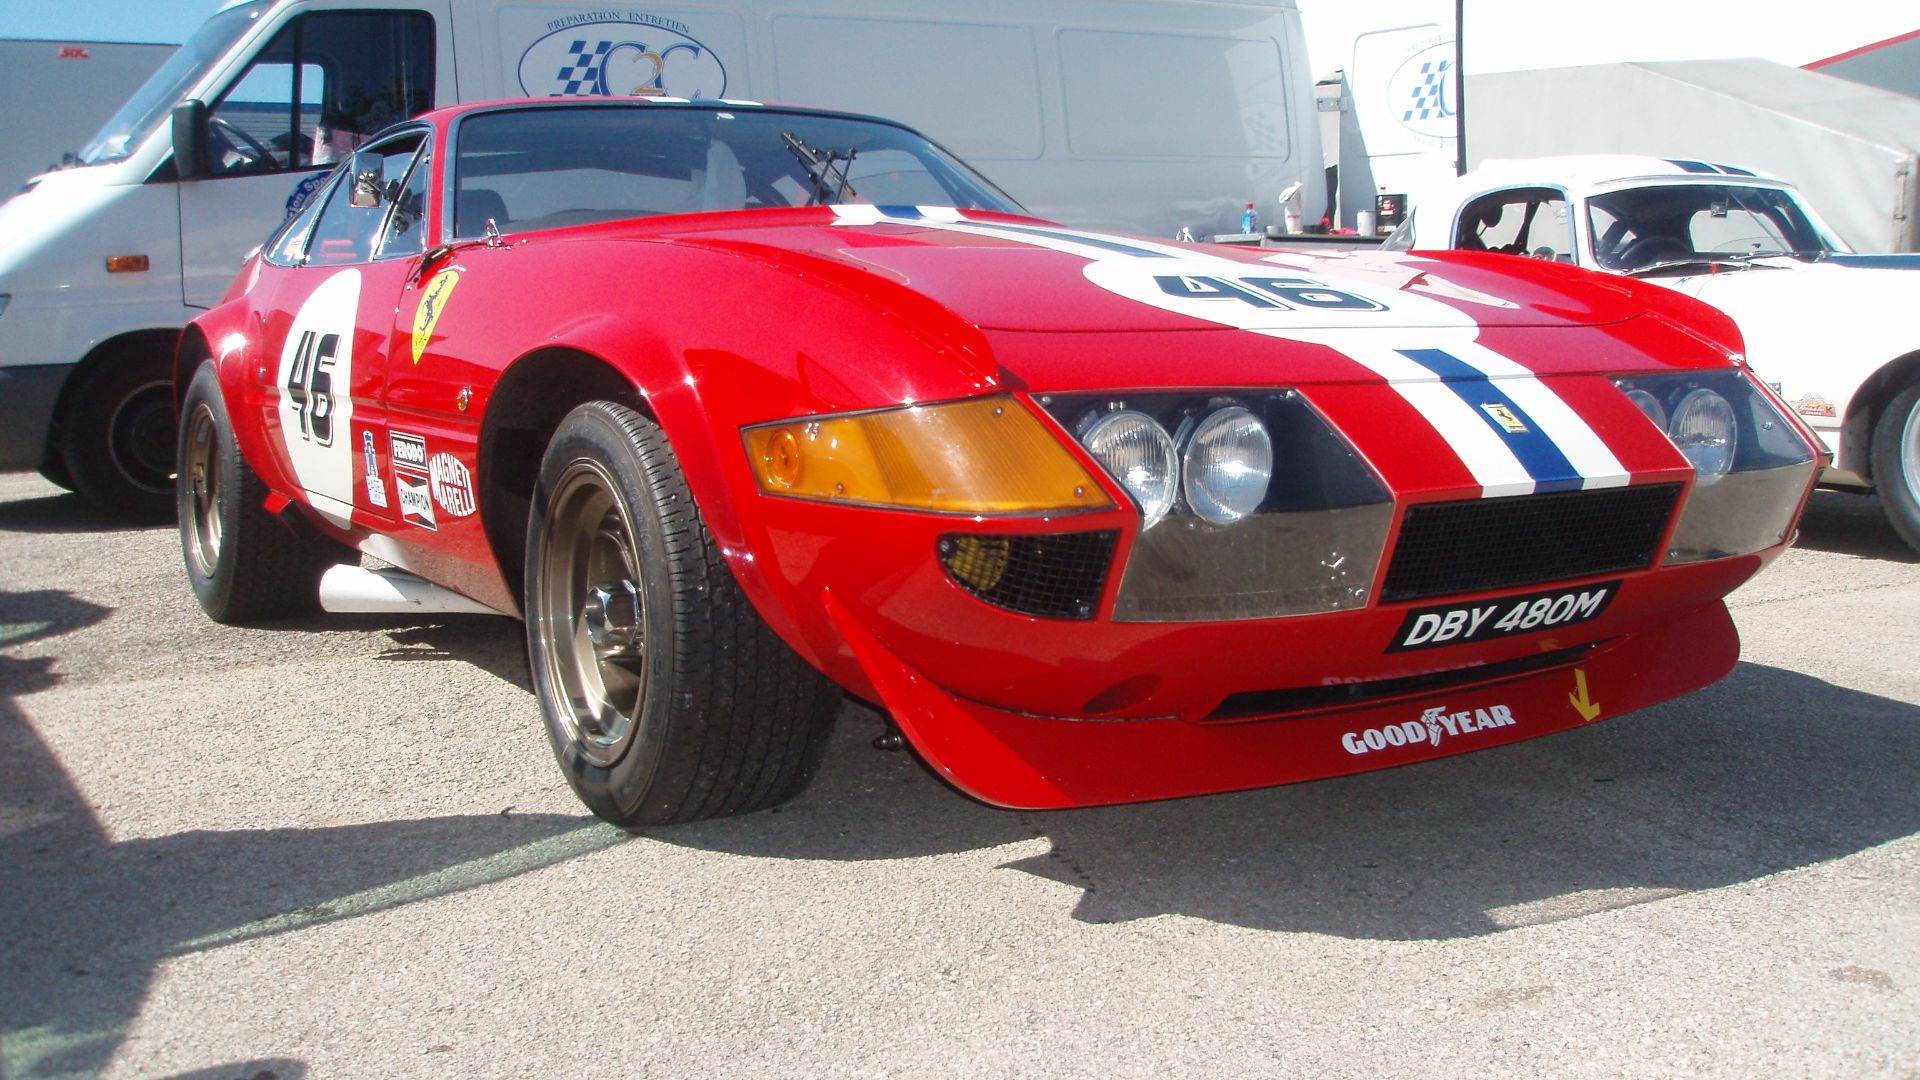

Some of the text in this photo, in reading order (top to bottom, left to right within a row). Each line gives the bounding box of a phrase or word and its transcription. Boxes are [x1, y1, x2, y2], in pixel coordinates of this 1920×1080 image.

[547, 11, 691, 33] PREPARATION ENTRETIEN
[1153, 275, 1390, 312] 46
[288, 331, 340, 448] 46
[393, 440, 424, 463] FERODO
[401, 488, 430, 511] CHAMPION
[1403, 589, 1607, 646] DBY 480M
[1341, 704, 1516, 755] GOODYEAR
